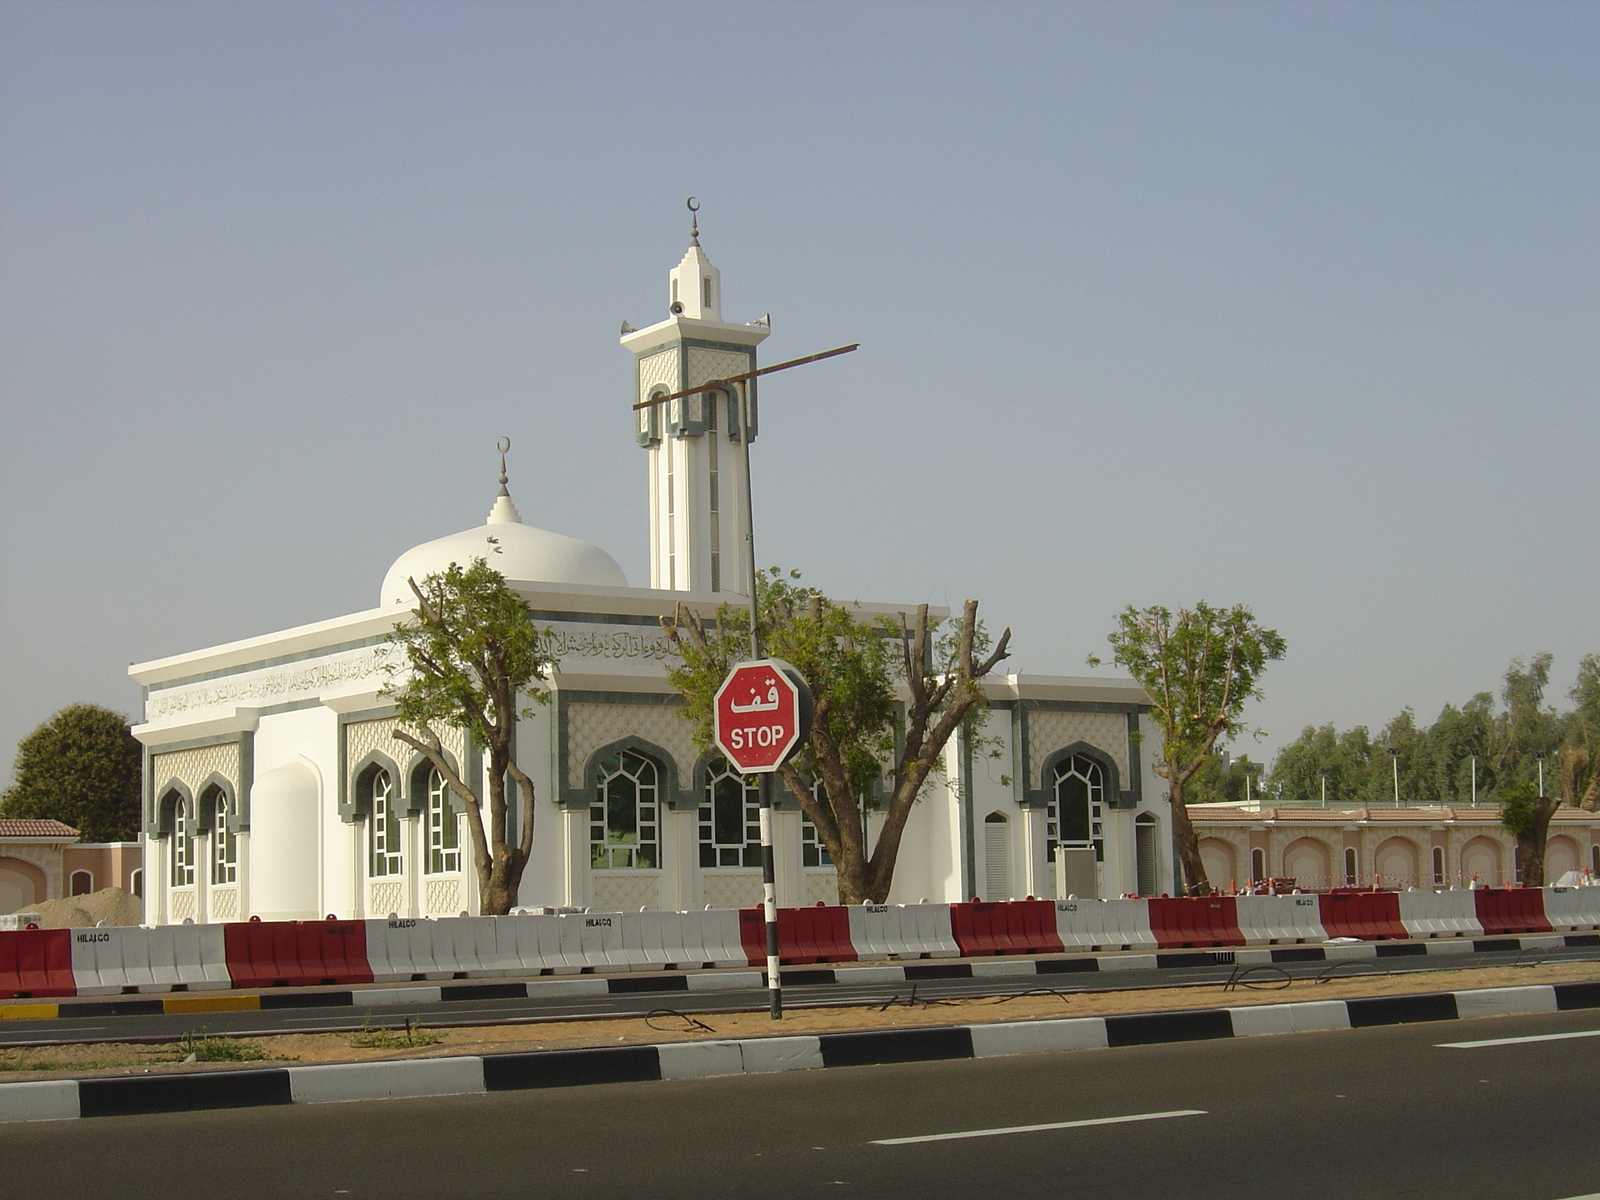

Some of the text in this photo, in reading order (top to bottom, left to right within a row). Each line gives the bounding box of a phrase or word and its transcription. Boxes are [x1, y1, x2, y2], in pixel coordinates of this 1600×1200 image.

[731, 678, 780, 714] قف
[731, 725, 784, 749] STOP
[866, 905, 888, 914] HILALCO
[388, 919, 417, 929] HILALCO
[585, 918, 612, 928] HILALCO
[77, 933, 110, 943] HILALCO
